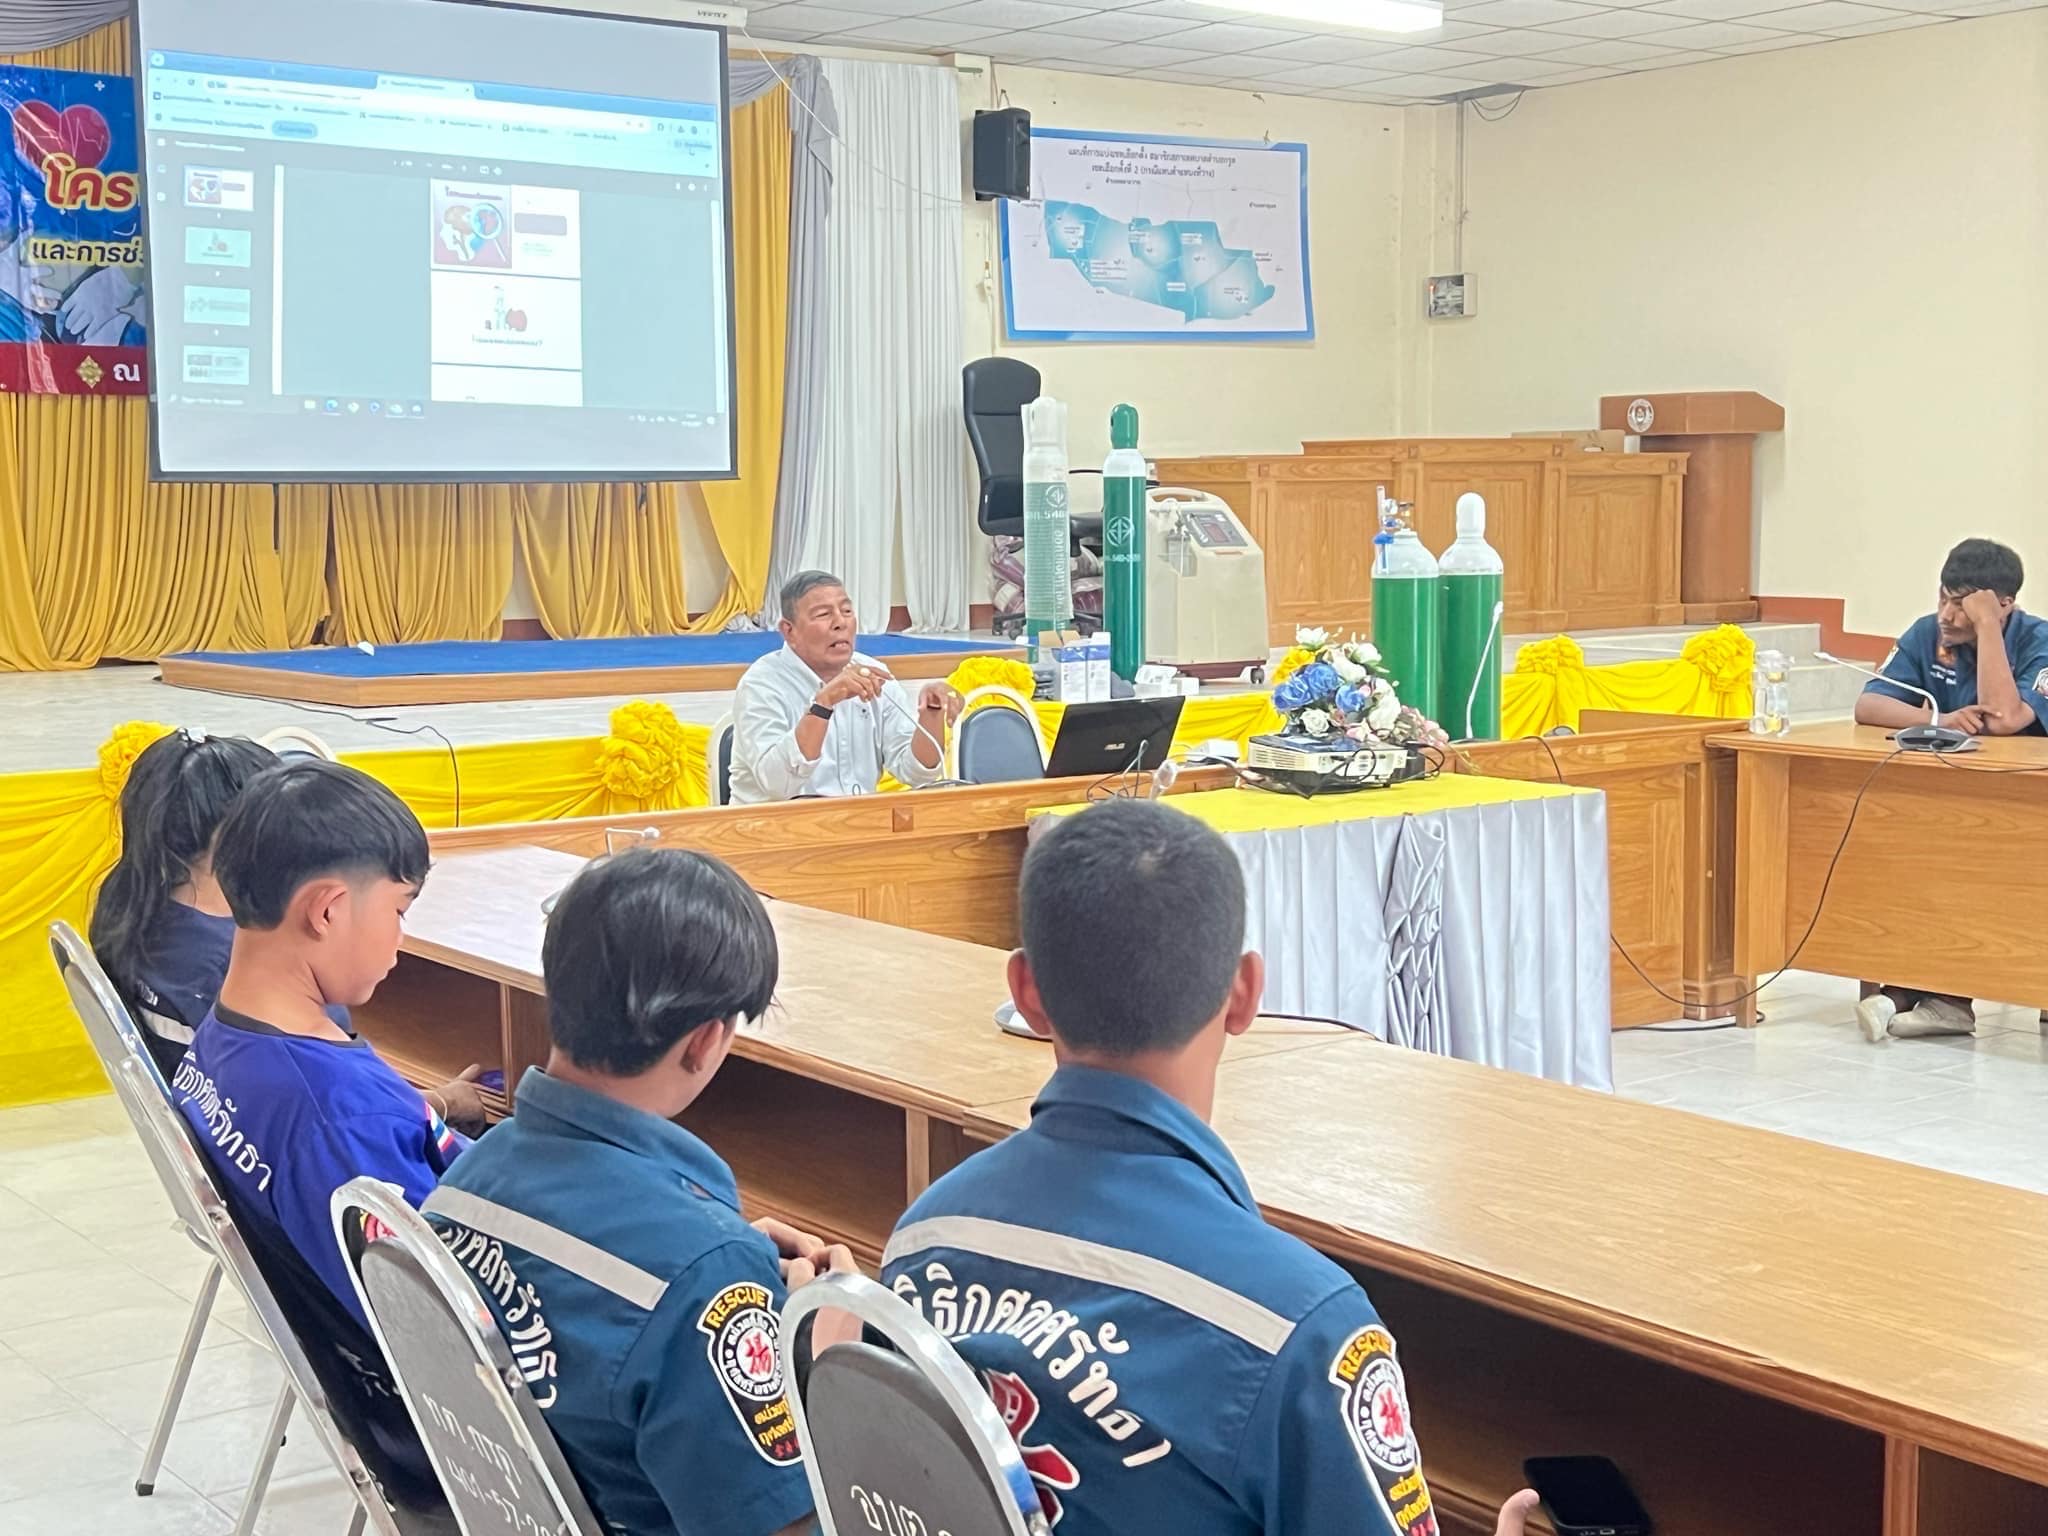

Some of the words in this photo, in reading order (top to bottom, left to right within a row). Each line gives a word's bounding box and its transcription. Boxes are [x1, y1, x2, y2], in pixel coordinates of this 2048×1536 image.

[44, 153, 139, 212] โคร
[113, 363, 141, 382] ณ
[706, 1287, 768, 1328] RESCUE
